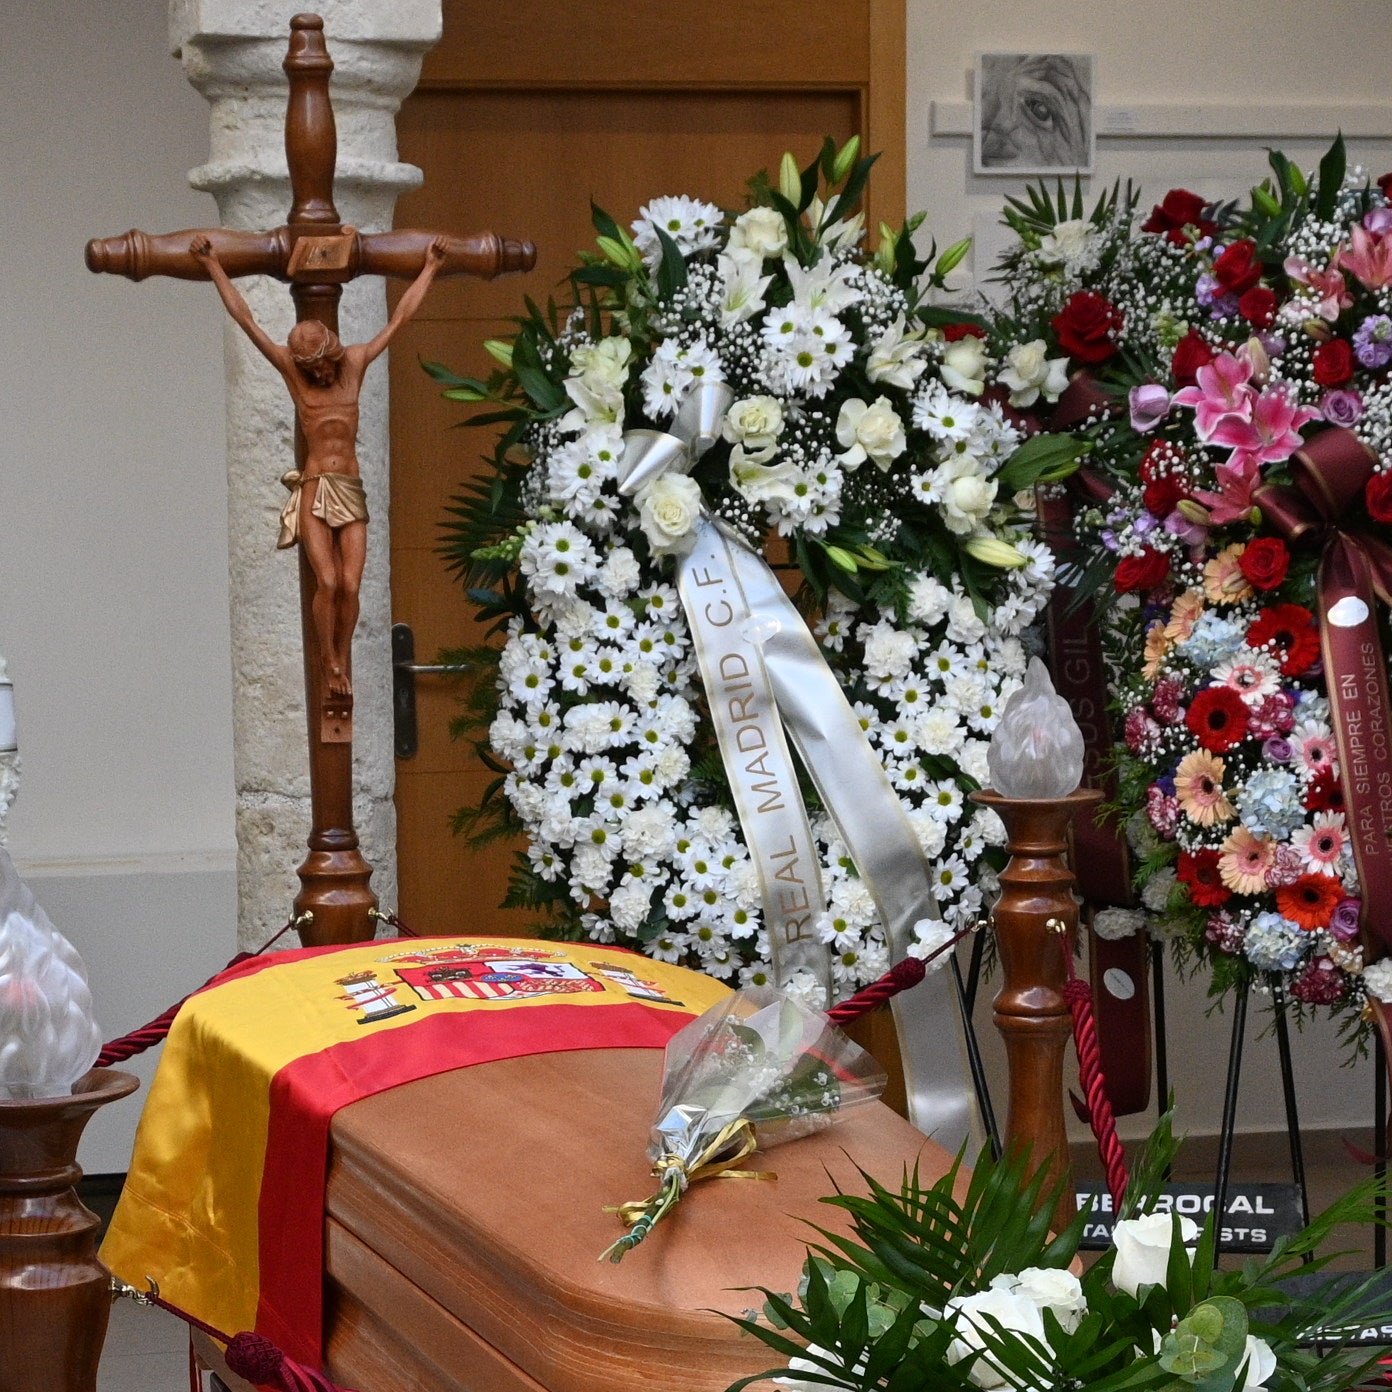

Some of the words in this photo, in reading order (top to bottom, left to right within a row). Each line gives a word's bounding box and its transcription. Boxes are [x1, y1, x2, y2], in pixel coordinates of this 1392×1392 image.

[691, 553, 734, 628] C.F.
[1062, 626, 1091, 684] GIL
[1341, 673, 1359, 700] EN
[718, 652, 786, 814] MADRID
[1361, 642, 1387, 761] CORAZONES
[1346, 709, 1371, 795] SIEMPRE
[1360, 805, 1380, 855] PARA
[769, 834, 814, 944] REAL
